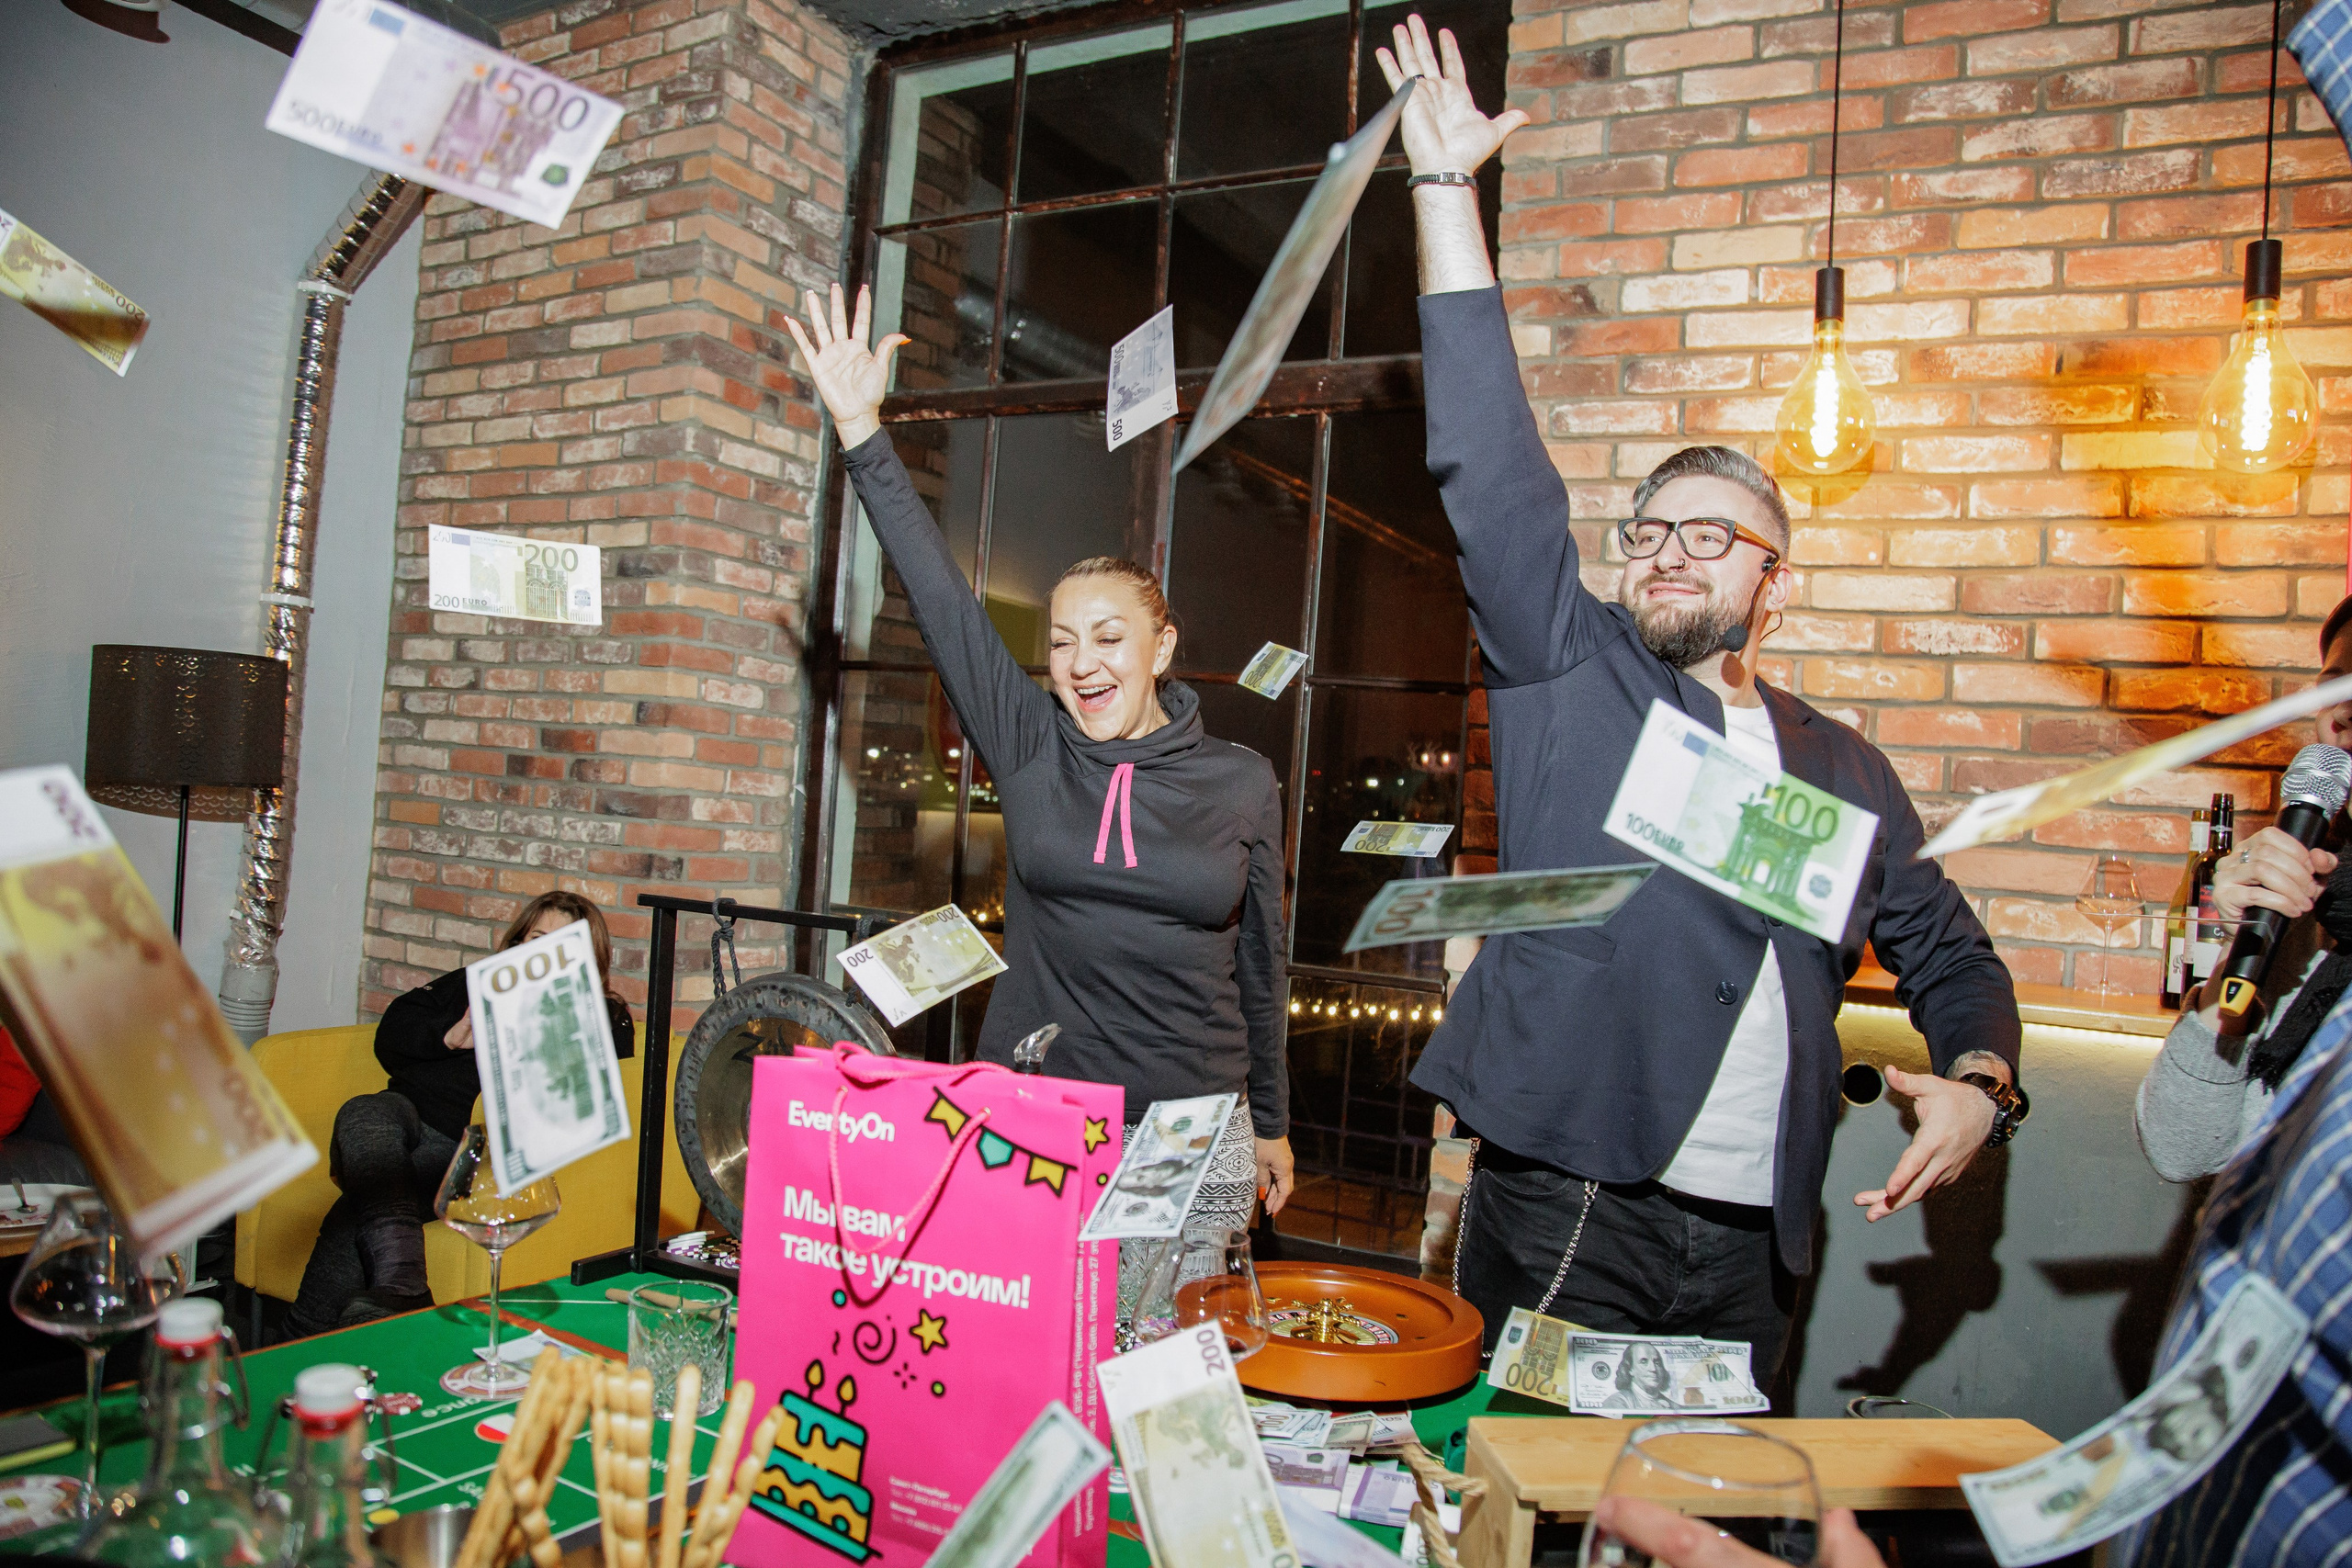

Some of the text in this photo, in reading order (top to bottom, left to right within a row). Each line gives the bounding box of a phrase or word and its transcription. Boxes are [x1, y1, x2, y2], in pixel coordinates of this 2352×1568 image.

[493, 68, 591, 131] 500
[1114, 344, 1125, 363] 500
[1112, 418, 1123, 442] 500
[525, 544, 579, 572] 200
[434, 594, 488, 608] 200 EURO
[1626, 813, 1656, 842] 100
[1771, 785, 1839, 843] 100
[1354, 840, 1386, 852] 200
[937, 907, 960, 922] 200
[492, 943, 576, 994] 100
[846, 948, 874, 967] 200
[784, 1185, 906, 1242] Мы вам
[780, 1232, 1031, 1309] такое устроим!
[1196, 1329, 1227, 1377] 200
[1505, 1362, 1554, 1396] 200
